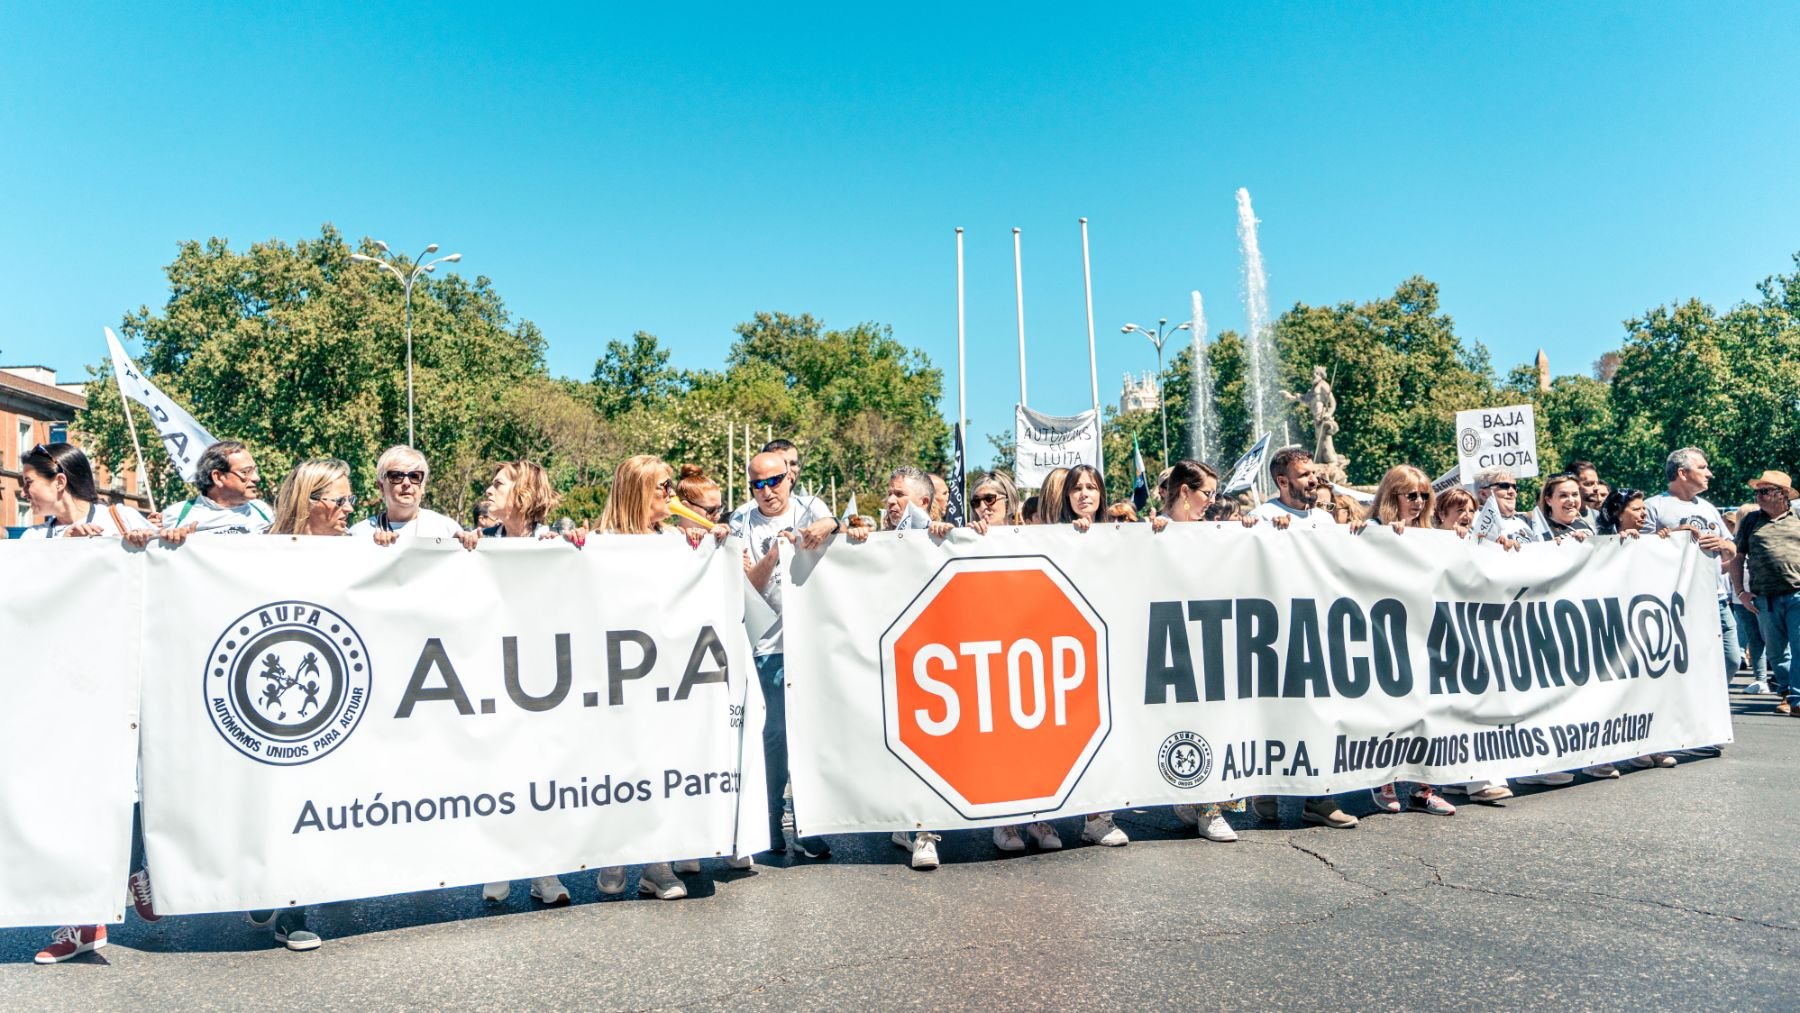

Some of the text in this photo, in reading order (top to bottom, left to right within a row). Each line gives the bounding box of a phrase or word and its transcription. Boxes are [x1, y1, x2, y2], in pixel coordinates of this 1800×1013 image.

[1482, 411, 1524, 429] BAJA
[1493, 431, 1519, 447] SIN
[1034, 451, 1082, 467] LLUITA
[258, 605, 321, 628] AUPA
[1426, 587, 1689, 695] AUTÓNOM@S
[1143, 597, 1413, 705] ATRACO
[912, 635, 1086, 736] STOP
[213, 686, 364, 759] AUTÓNOMOS UNIDOS PARA ACTUAR
[1221, 739, 1319, 781] A.U.P.A.
[1333, 731, 1469, 774] Autónomos
[1473, 723, 1550, 762] unidos
[1548, 721, 1600, 758] para
[1601, 712, 1654, 746] actuar
[292, 792, 516, 834] Autónomos
[529, 774, 651, 811] Unidos
